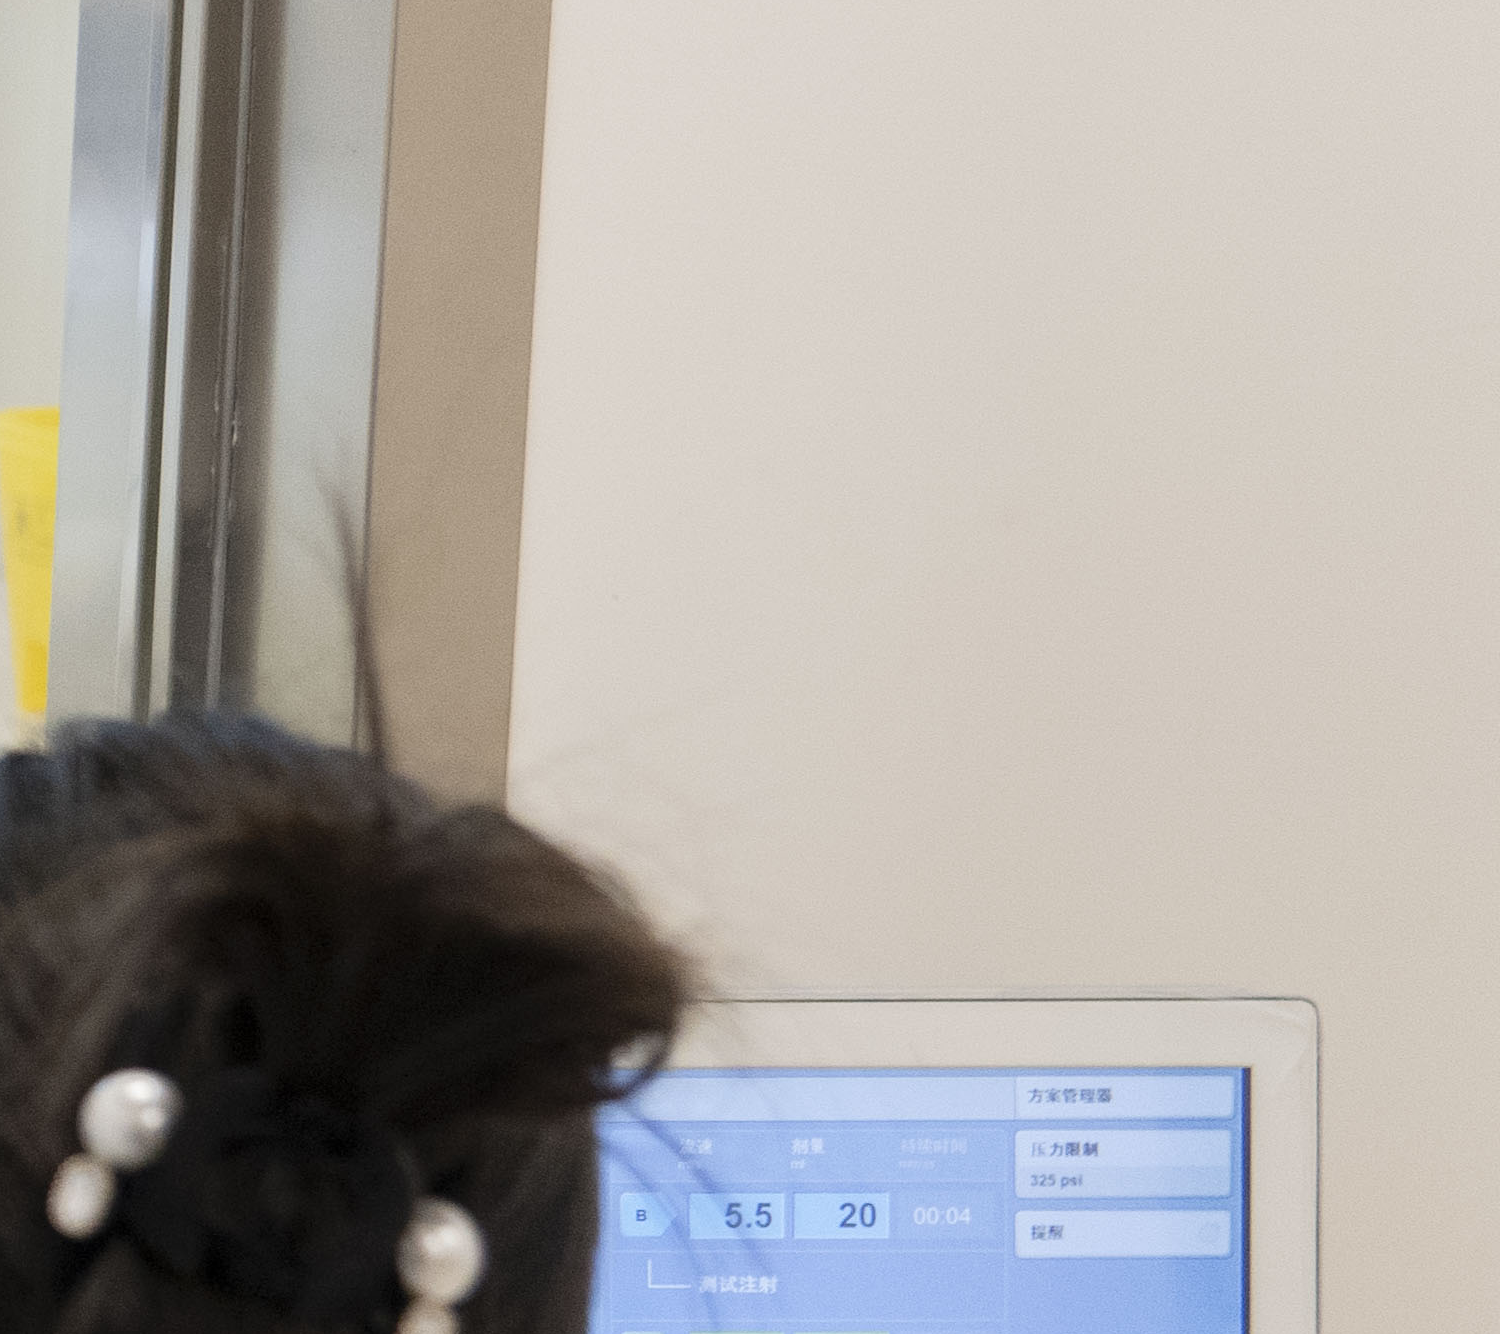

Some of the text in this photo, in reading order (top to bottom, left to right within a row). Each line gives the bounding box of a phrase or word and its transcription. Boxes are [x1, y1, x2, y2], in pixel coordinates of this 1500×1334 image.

[1026, 1087, 1113, 1105] 方案管理器
[1029, 1141, 1100, 1159] 压力限制
[1029, 1173, 1084, 1191] 325 psi
[635, 1201, 971, 1229] B 5.5 20 00:04
[698, 1274, 779, 1295] 测试注射
